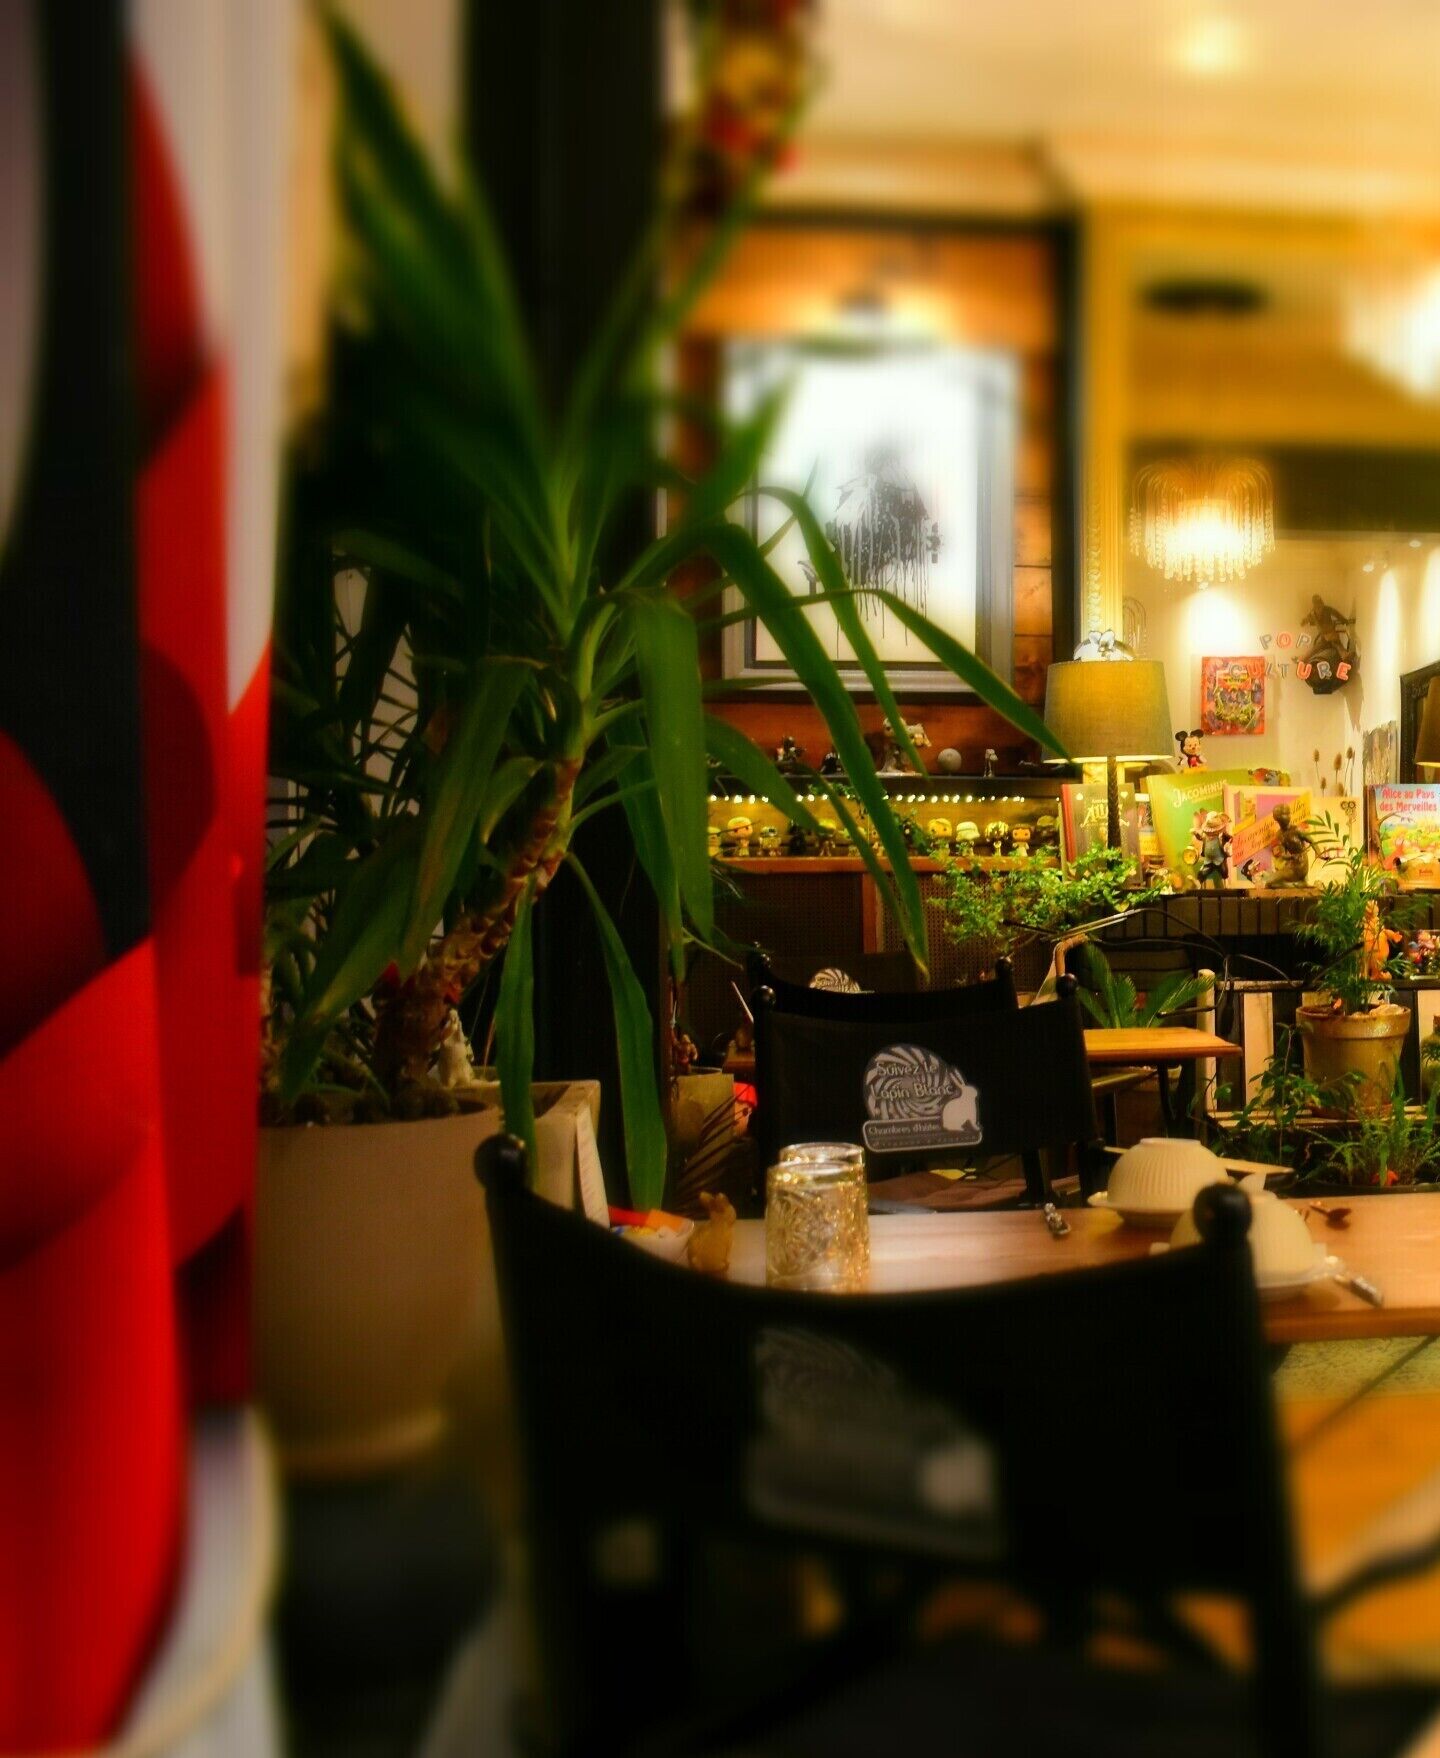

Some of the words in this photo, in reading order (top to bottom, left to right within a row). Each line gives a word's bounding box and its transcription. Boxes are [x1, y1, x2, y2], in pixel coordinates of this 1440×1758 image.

[1259, 631, 1311, 650] POP
[1229, 660, 1351, 681] CULTURE
[1383, 788, 1402, 799] Alice
[1403, 791, 1413, 799] au
[1416, 788, 1435, 800] Pays
[1380, 803, 1393, 811] des
[1396, 802, 1437, 812] Merveilles
[877, 1061, 919, 1077] Suivez
[924, 1061, 938, 1074] le
[871, 1084, 910, 1102] Lapin
[914, 1082, 953, 1098] Blanc
